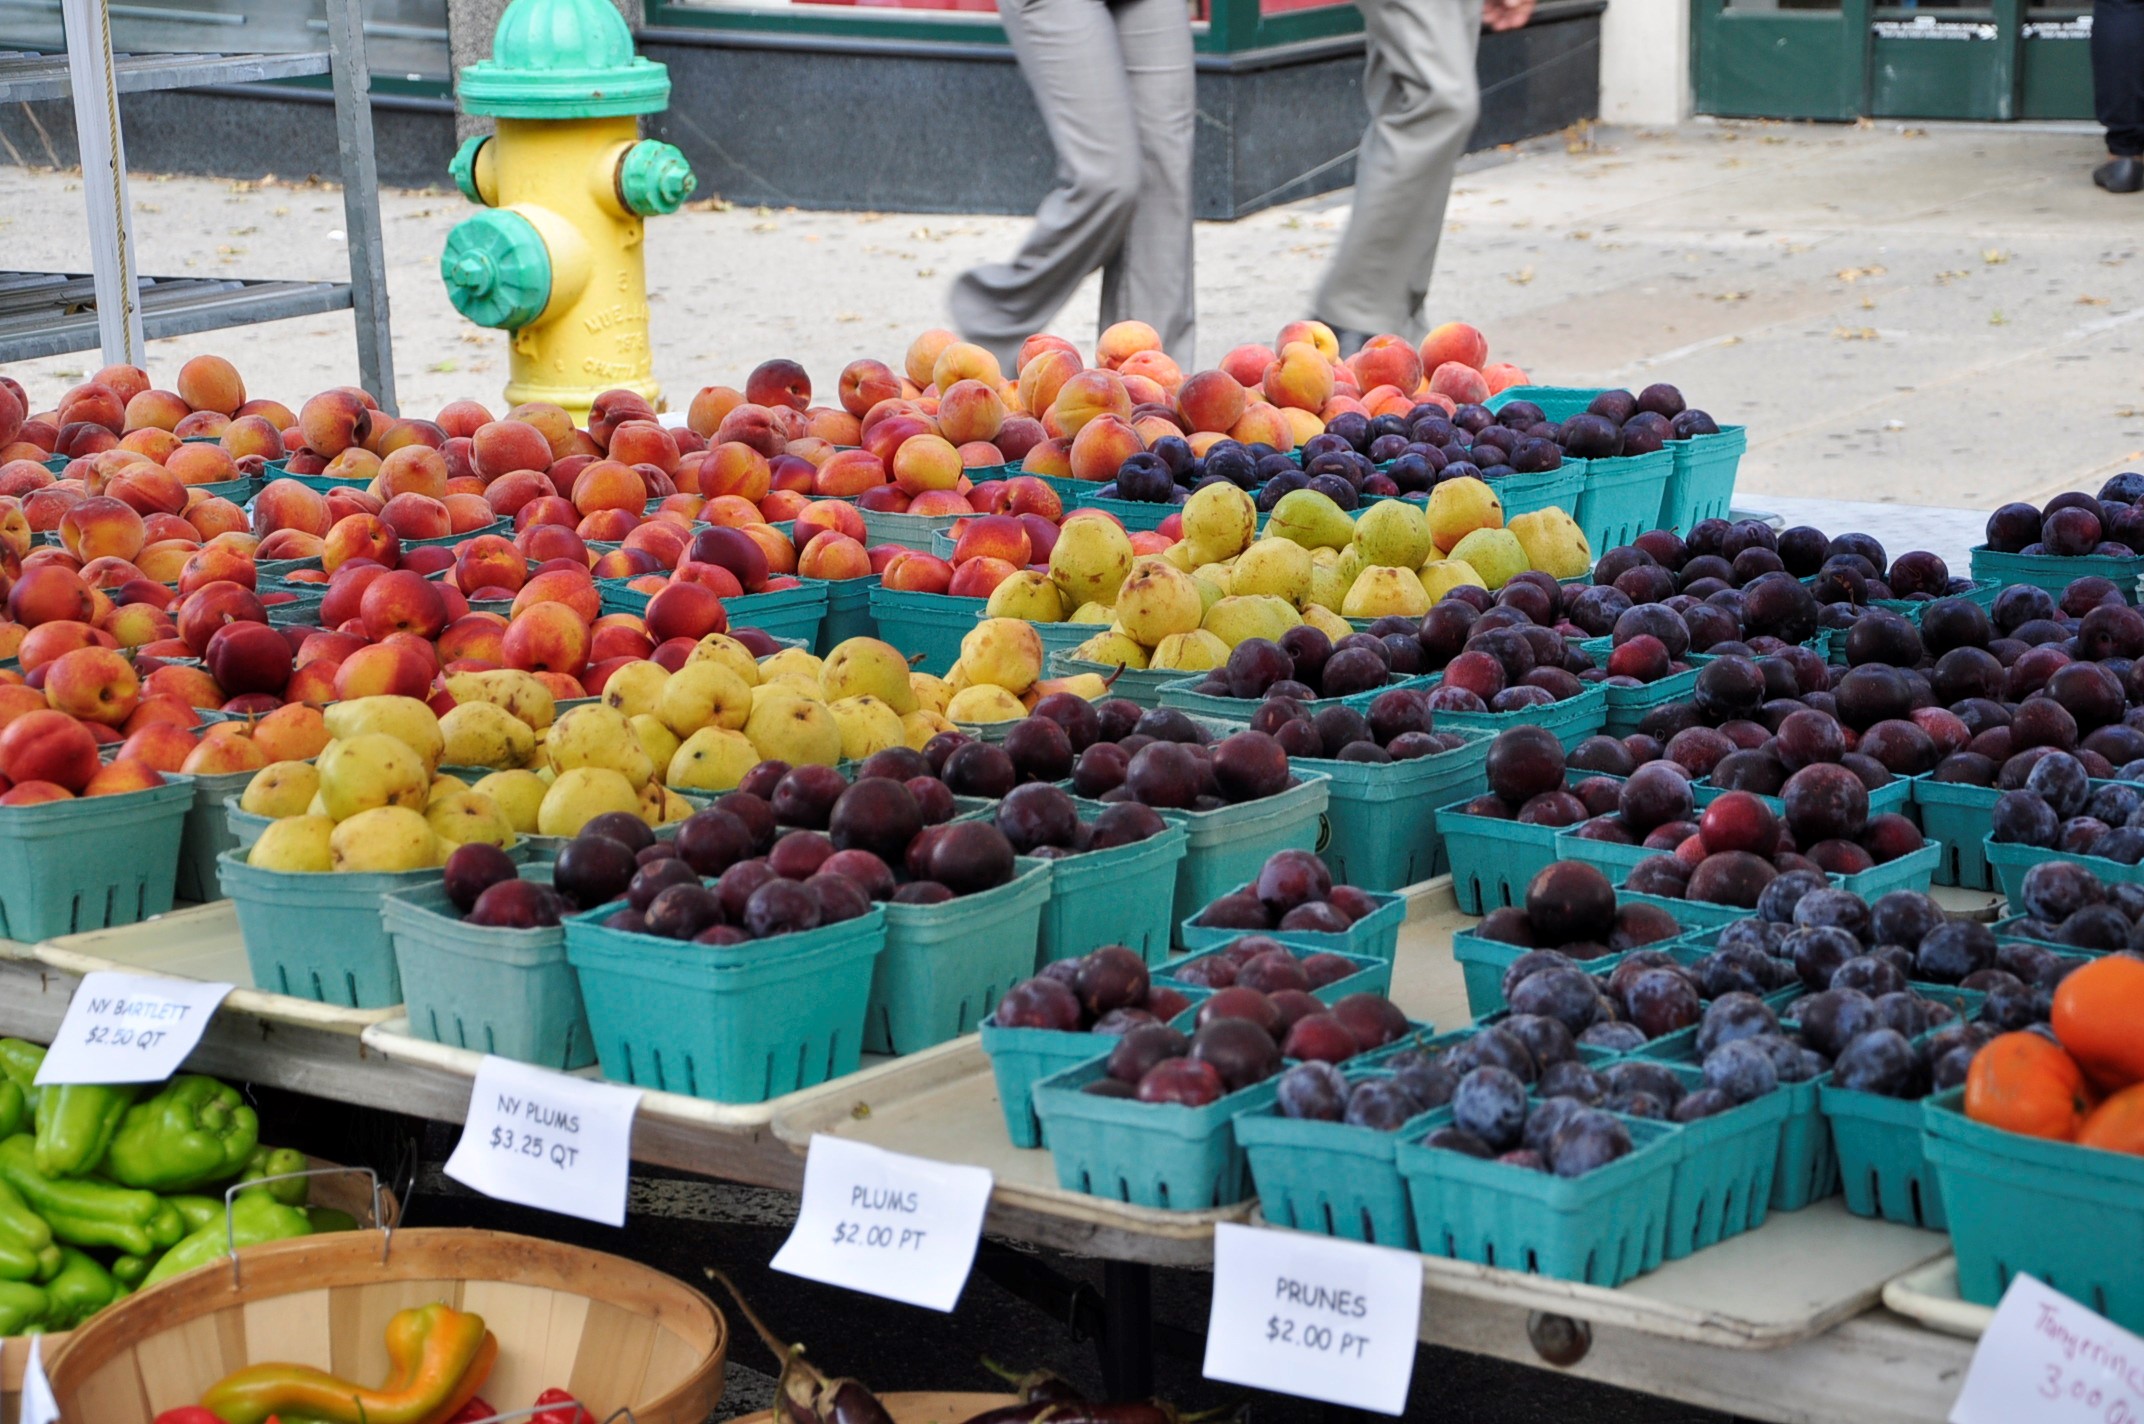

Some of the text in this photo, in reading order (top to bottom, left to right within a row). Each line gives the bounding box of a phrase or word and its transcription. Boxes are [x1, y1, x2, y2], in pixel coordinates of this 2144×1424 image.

[87, 998, 191, 1020] NY BARTLETT
[85, 1025, 167, 1050] $2.50 QT
[497, 1094, 580, 1134] NY PLUMS
[489, 1124, 580, 1170] $3.25 QT
[851, 1185, 918, 1213] PLUMS
[832, 1220, 927, 1250] $2.00 PT
[1276, 1276, 1367, 1318] PRUNES
[1265, 1315, 1371, 1359] $2.00 PT
